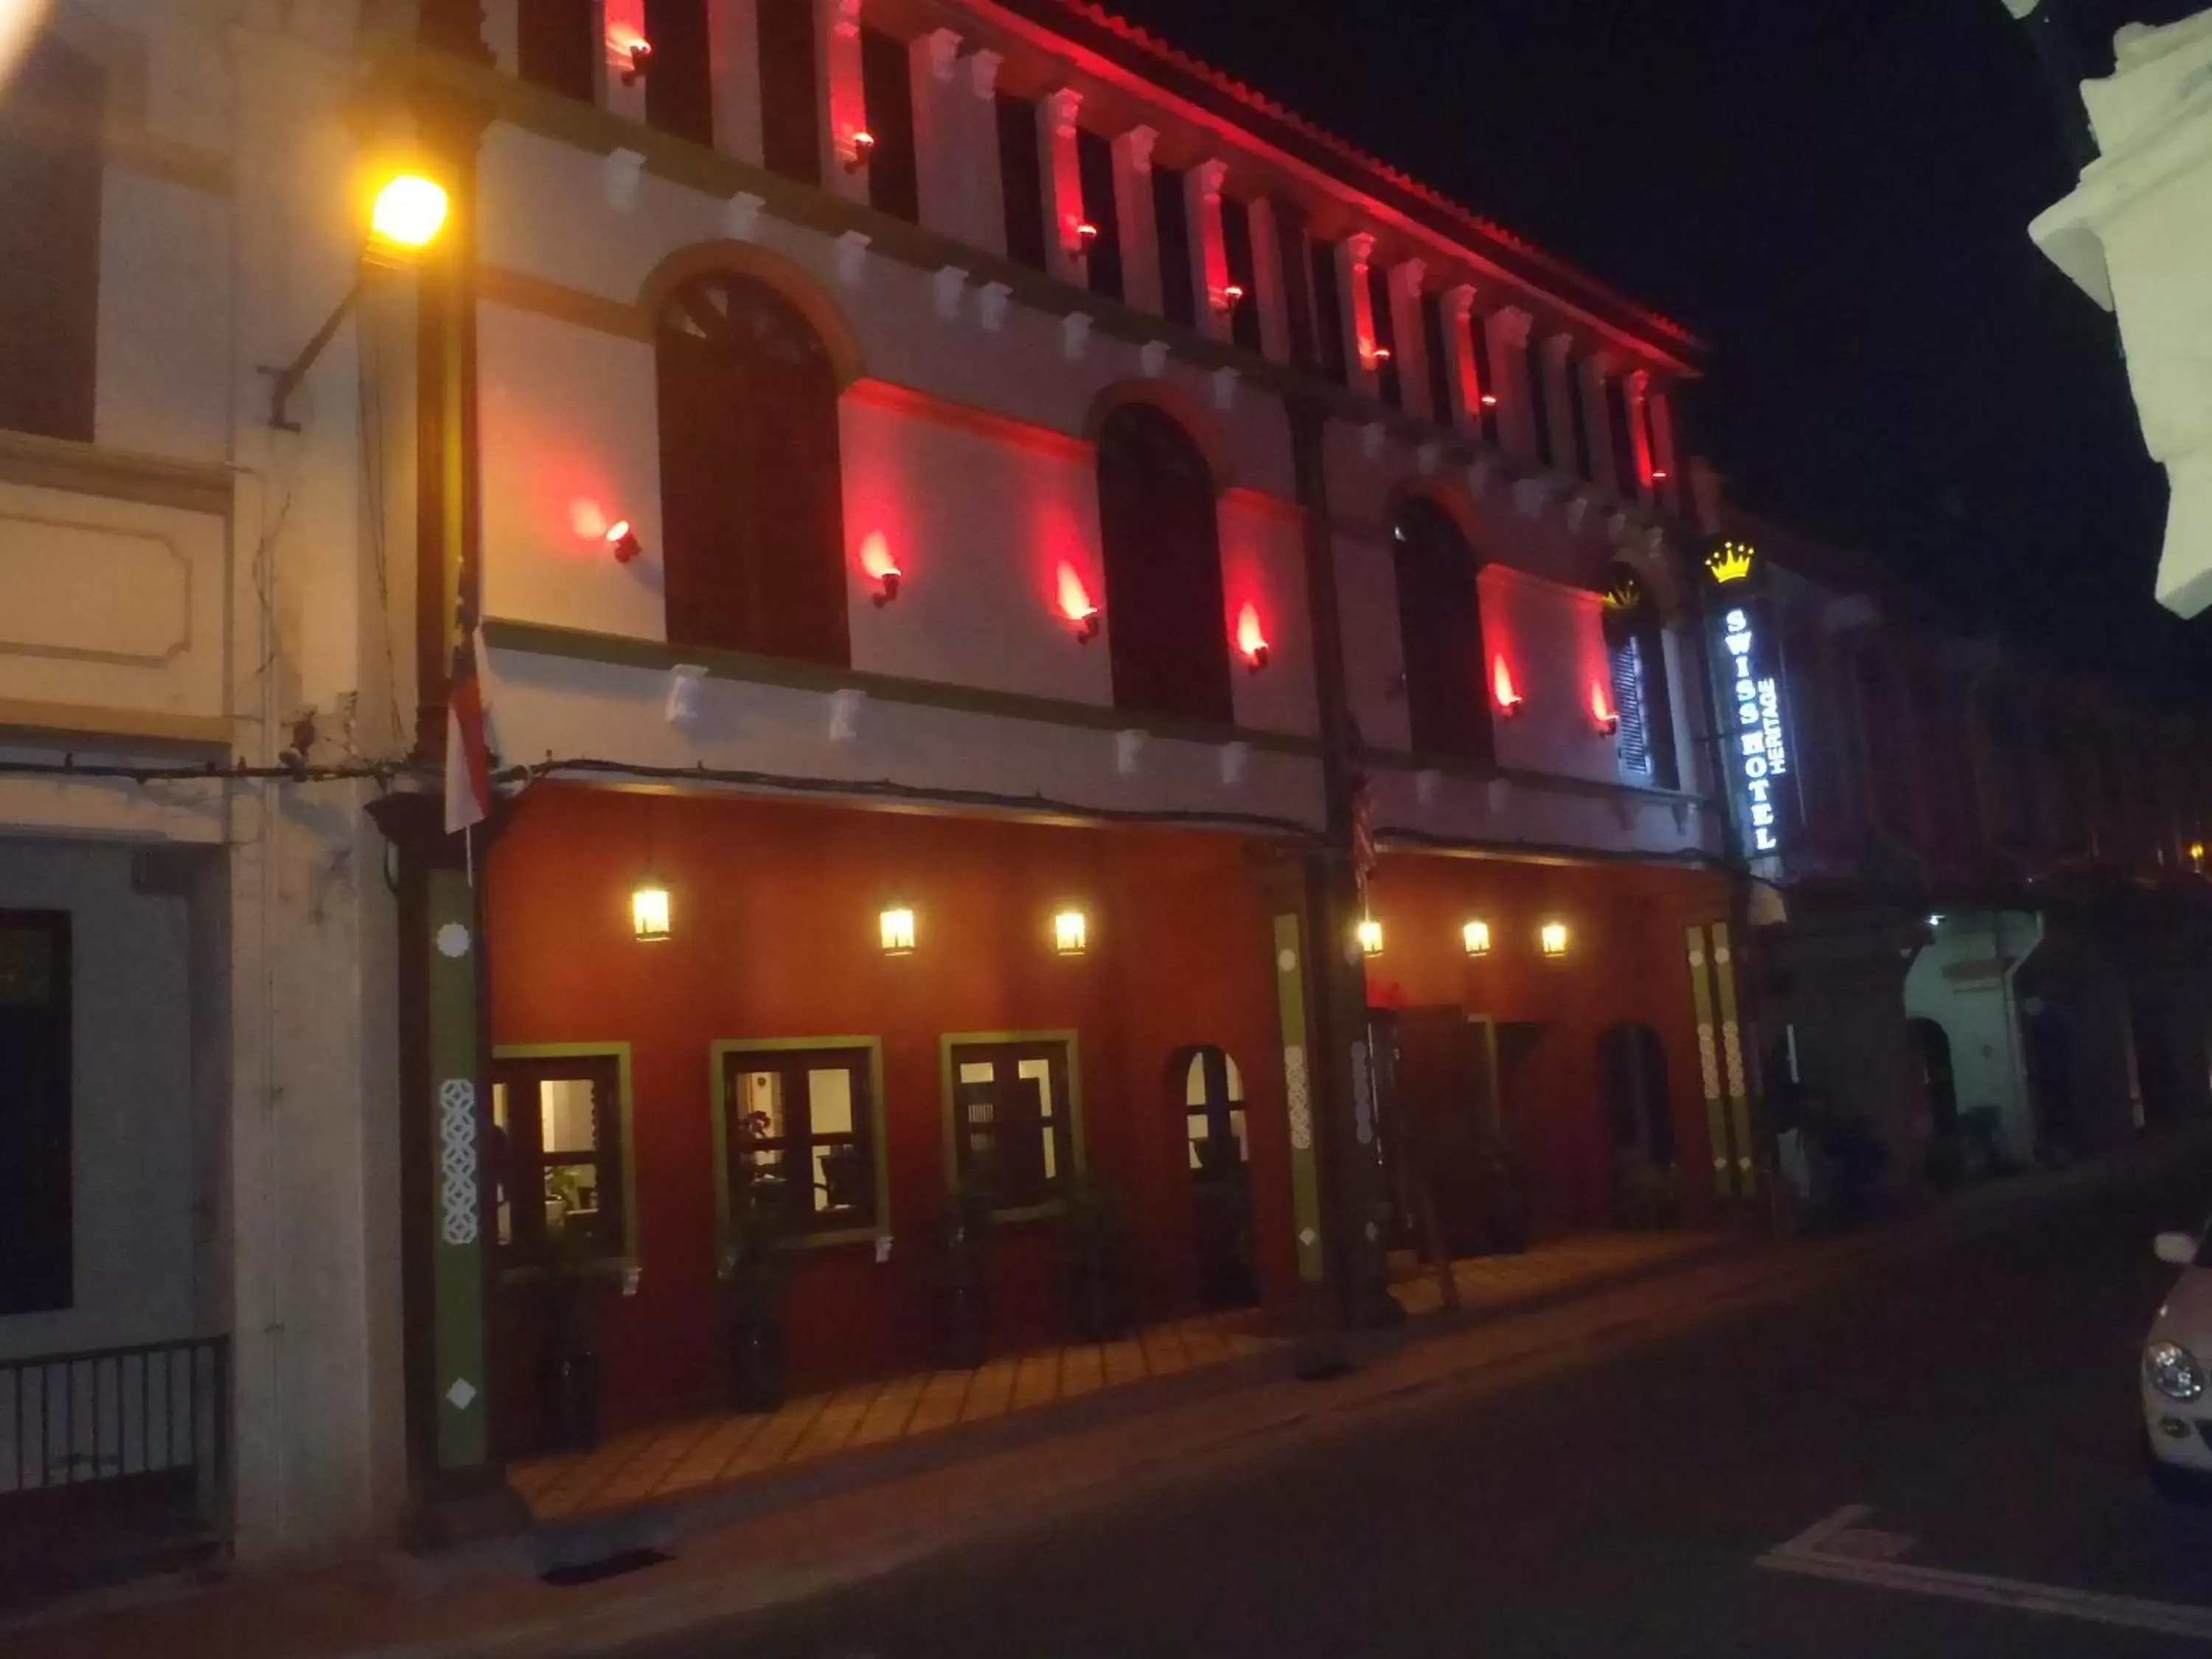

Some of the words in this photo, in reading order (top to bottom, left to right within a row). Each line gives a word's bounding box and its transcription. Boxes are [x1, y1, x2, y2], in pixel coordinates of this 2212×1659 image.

[1725, 609, 1759, 724] SWISS
[1758, 678, 1786, 774] HERITAGE
[1741, 732, 1776, 849] HOTEL
